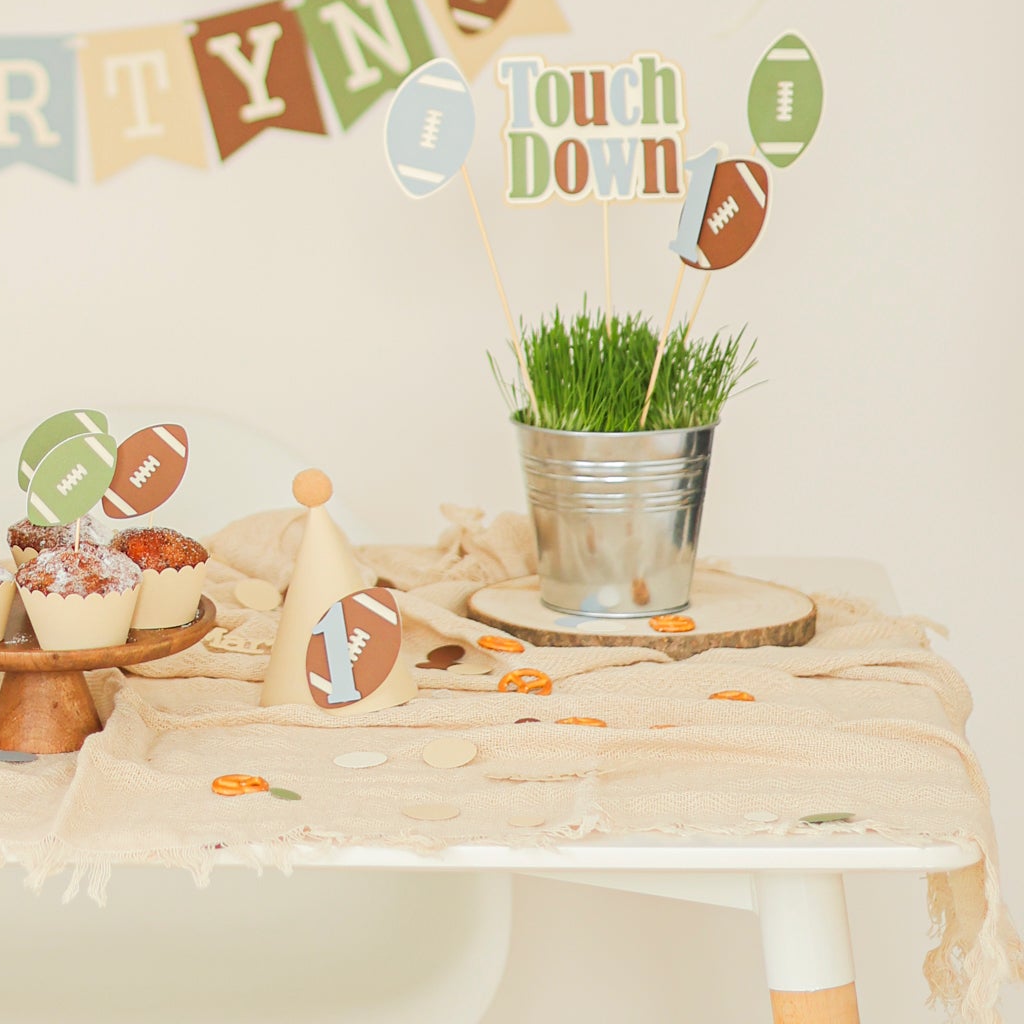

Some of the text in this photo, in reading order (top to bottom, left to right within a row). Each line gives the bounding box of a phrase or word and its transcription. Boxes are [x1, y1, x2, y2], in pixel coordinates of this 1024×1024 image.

[500, 57, 680, 128] Touch
[508, 131, 681, 199] Down
[312, 601, 362, 704] 1
